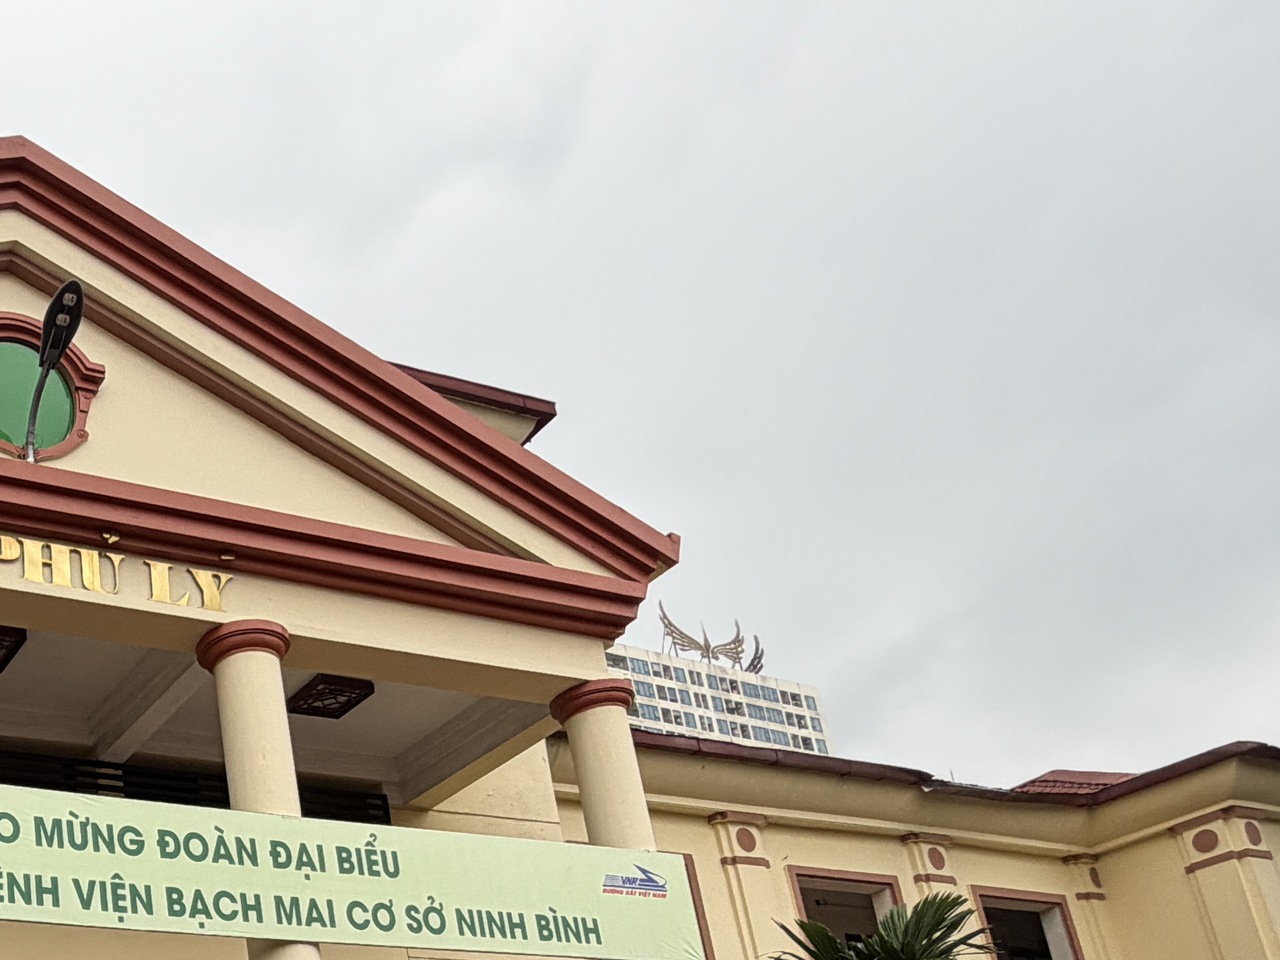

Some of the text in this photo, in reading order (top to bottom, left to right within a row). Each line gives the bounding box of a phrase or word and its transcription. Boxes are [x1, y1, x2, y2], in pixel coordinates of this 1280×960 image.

[34, 810, 144, 857] MỪNG
[157, 827, 258, 867] ĐOÀN
[270, 841, 326, 881] ĐẠI
[336, 833, 400, 879] BIỂU
[621, 876, 639, 886] VNR
[72, 872, 152, 923] VIỆN
[166, 886, 264, 929] BẠCH
[274, 895, 337, 929] MAI
[347, 899, 397, 933] CƠ
[406, 896, 447, 935] SỞ
[455, 908, 528, 941] NINH
[536, 906, 603, 945] BÌNH
